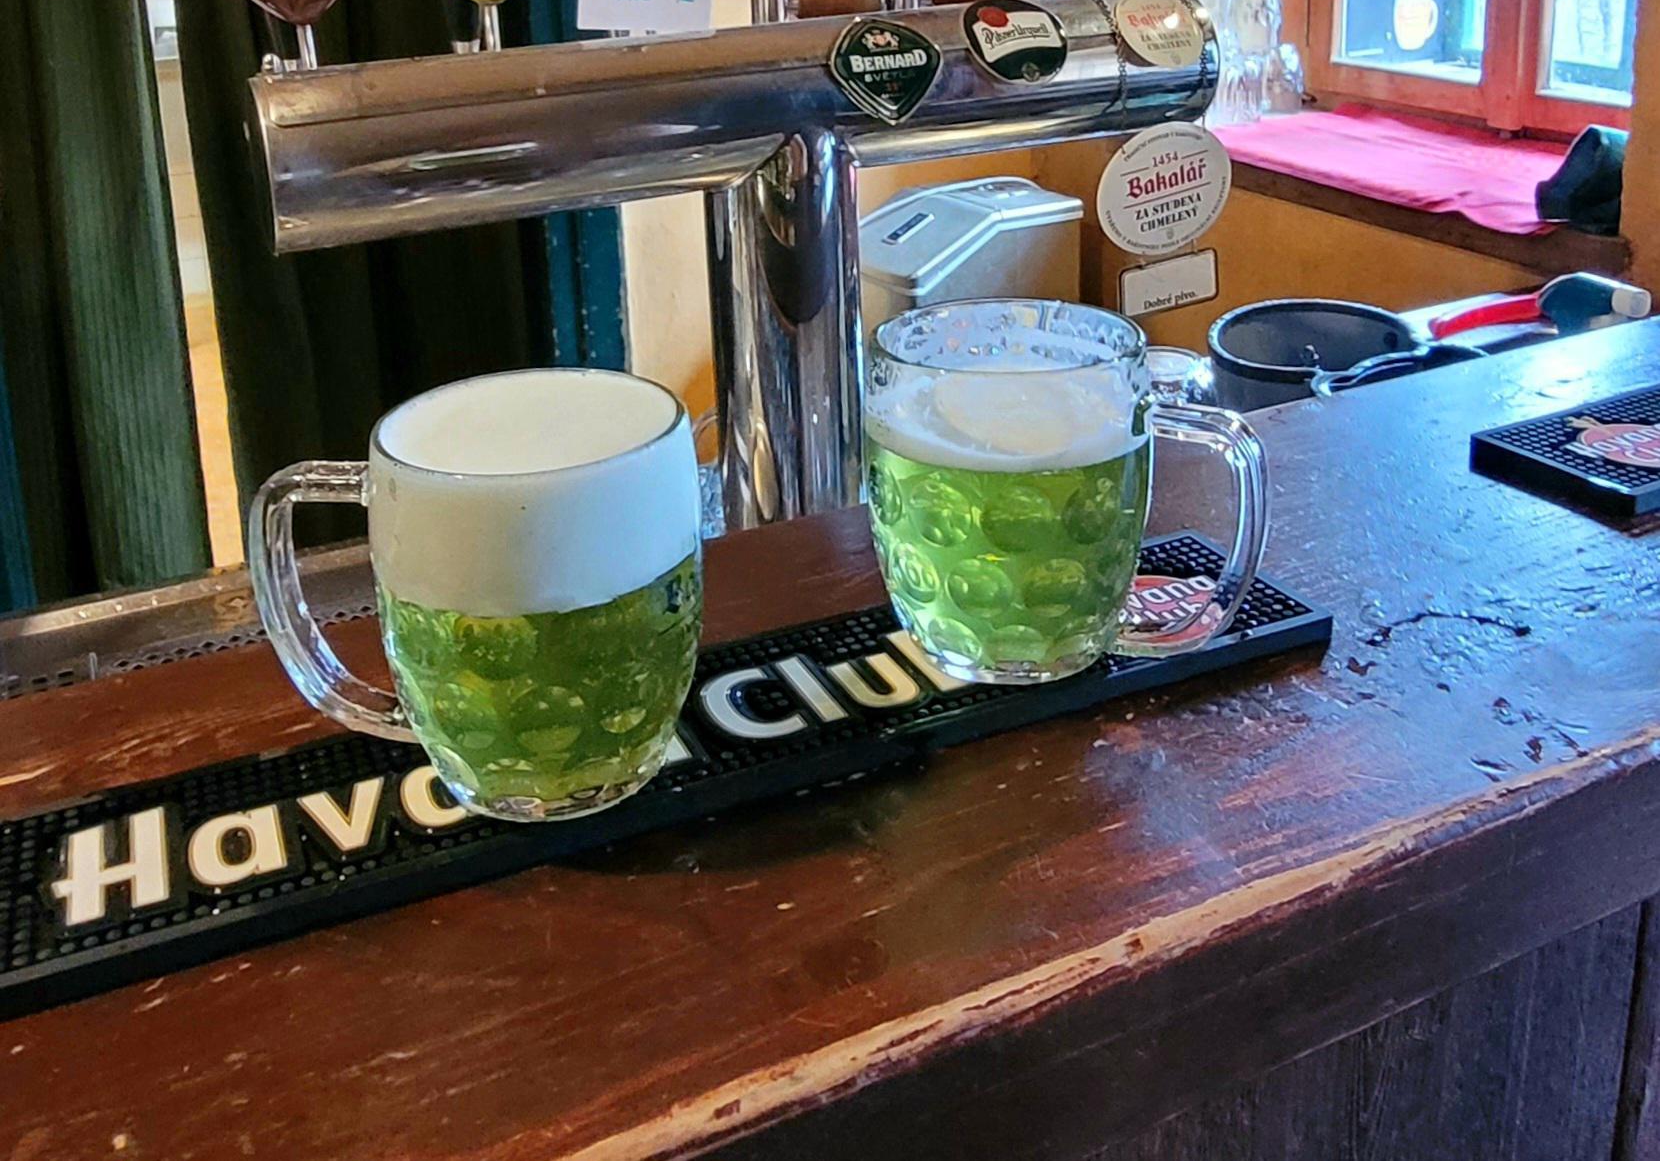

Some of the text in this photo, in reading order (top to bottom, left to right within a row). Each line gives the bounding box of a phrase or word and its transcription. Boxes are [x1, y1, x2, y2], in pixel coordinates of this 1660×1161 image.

[848, 49, 927, 73] BERNARD
[1152, 150, 1179, 169] 1454
[1126, 158, 1207, 199] Bakalář
[1135, 208, 1150, 221] ZA
[1144, 292, 1173, 310] Dobré
